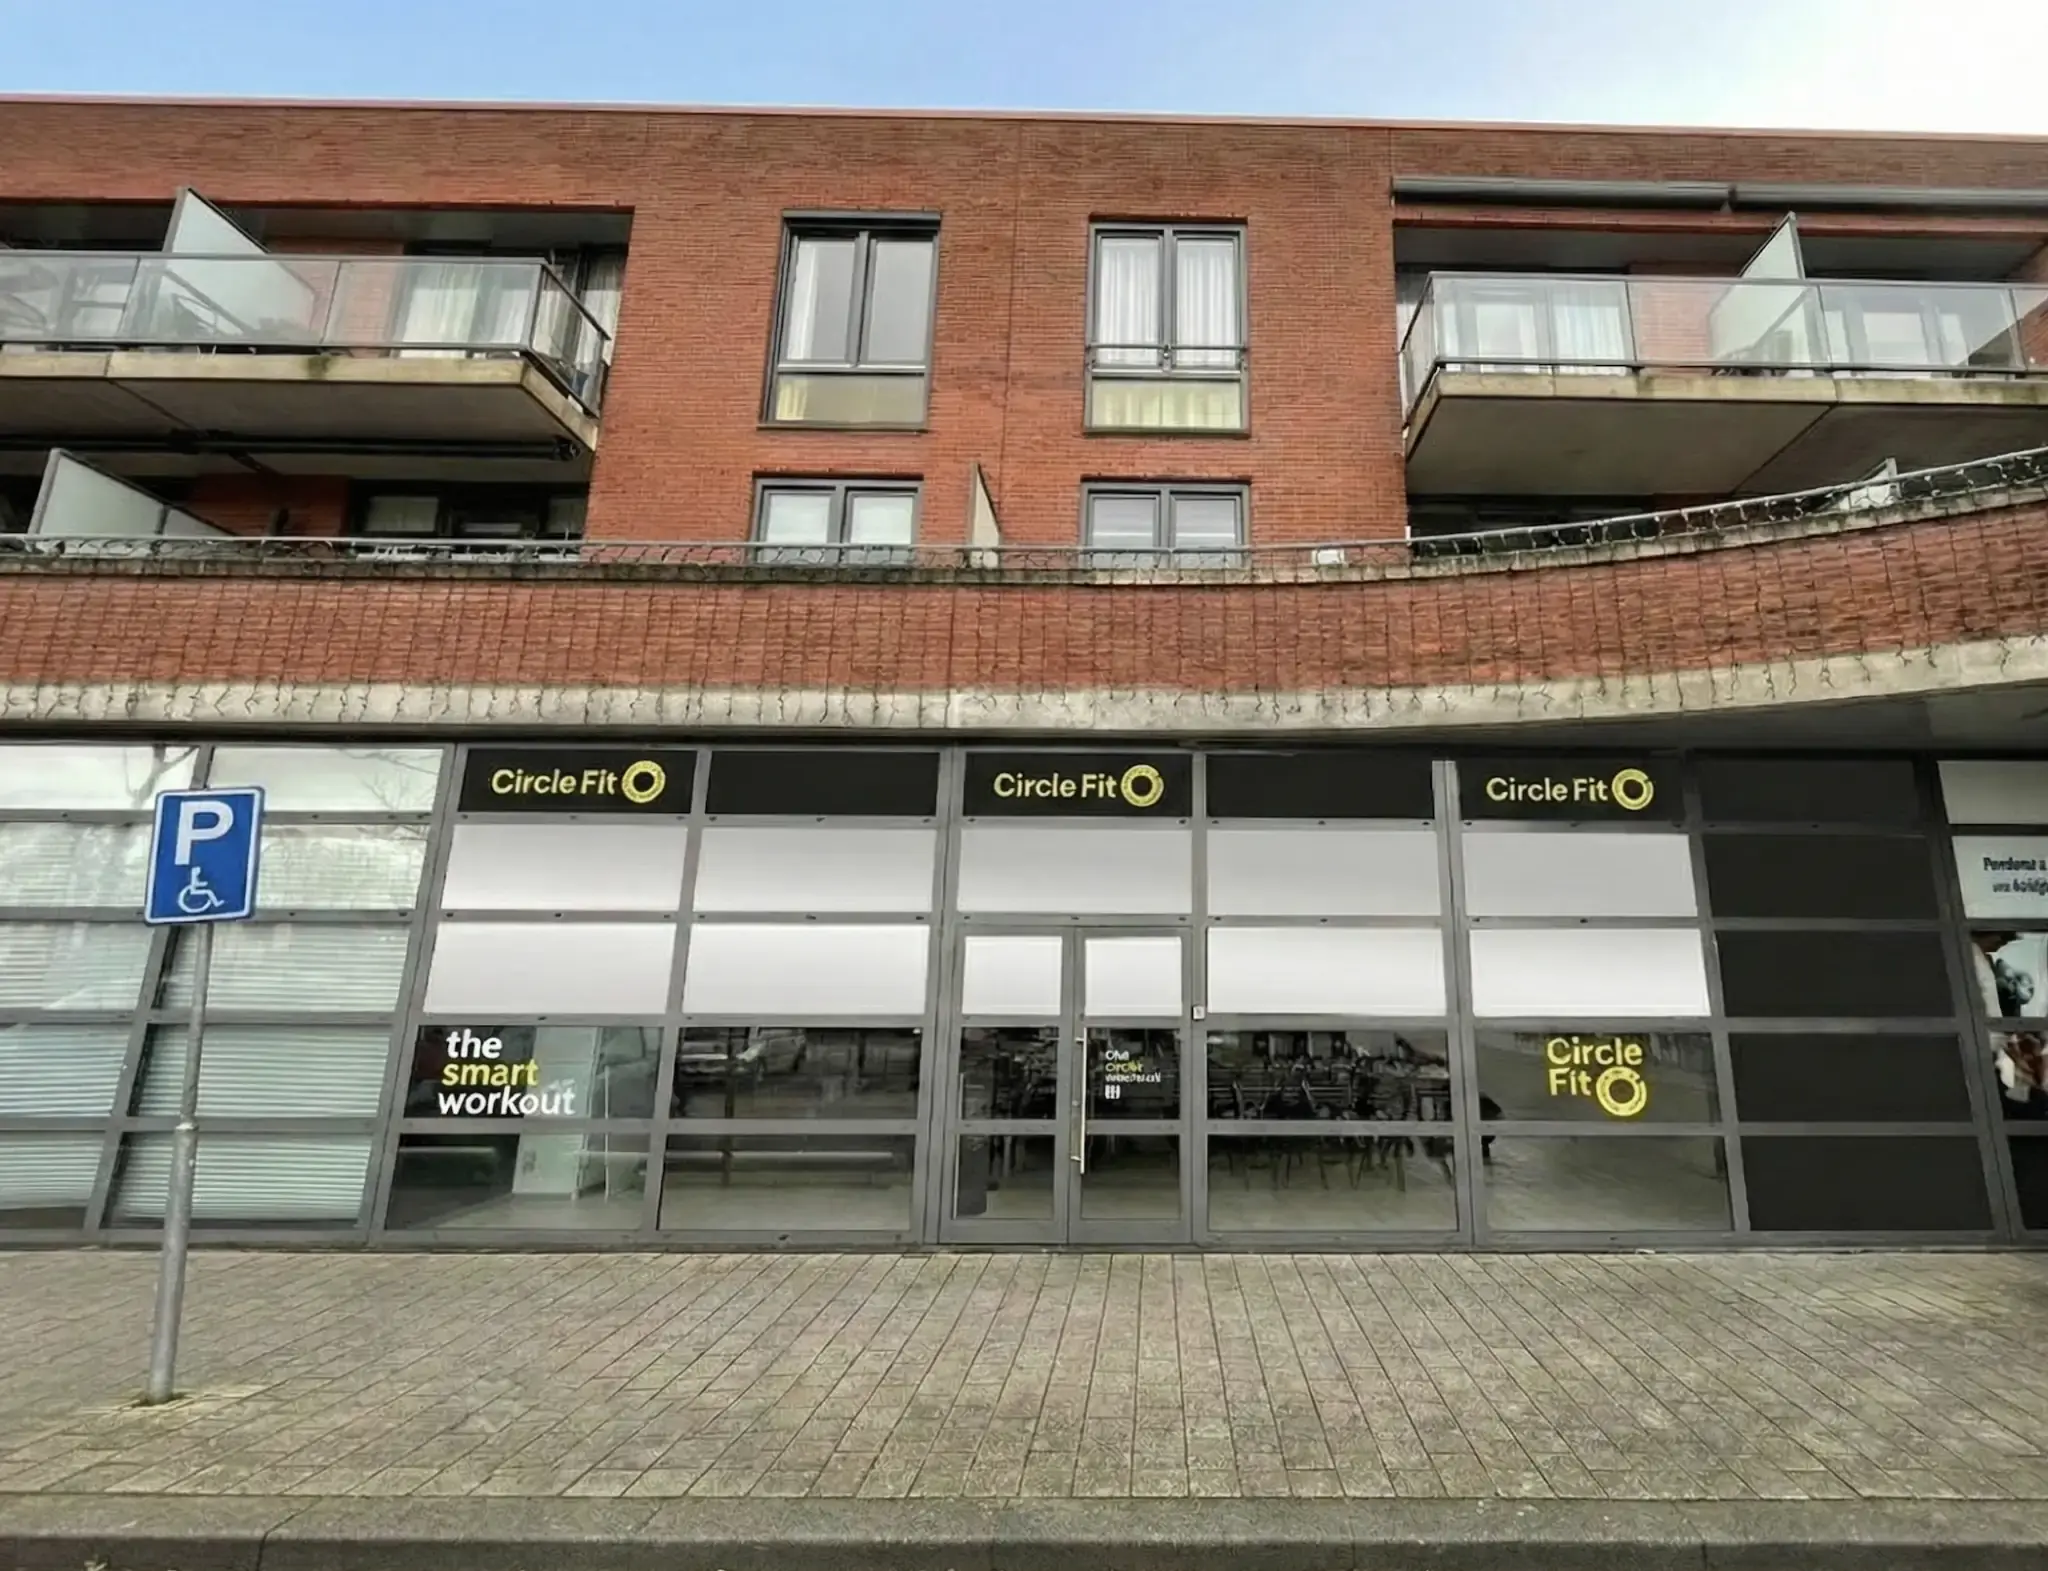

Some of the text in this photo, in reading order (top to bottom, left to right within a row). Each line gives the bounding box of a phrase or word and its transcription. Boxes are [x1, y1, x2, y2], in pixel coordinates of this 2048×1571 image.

[491, 768, 618, 795] Circle Fit
[993, 772, 1117, 798] Circle Fit
[1486, 777, 1609, 801] Circle Fit
[174, 800, 234, 865] P
[446, 1028, 503, 1059] the
[1547, 1036, 1643, 1066] Circle
[441, 1059, 539, 1087] smart
[1549, 1067, 1592, 1096] Fit
[438, 1085, 576, 1115] workout
